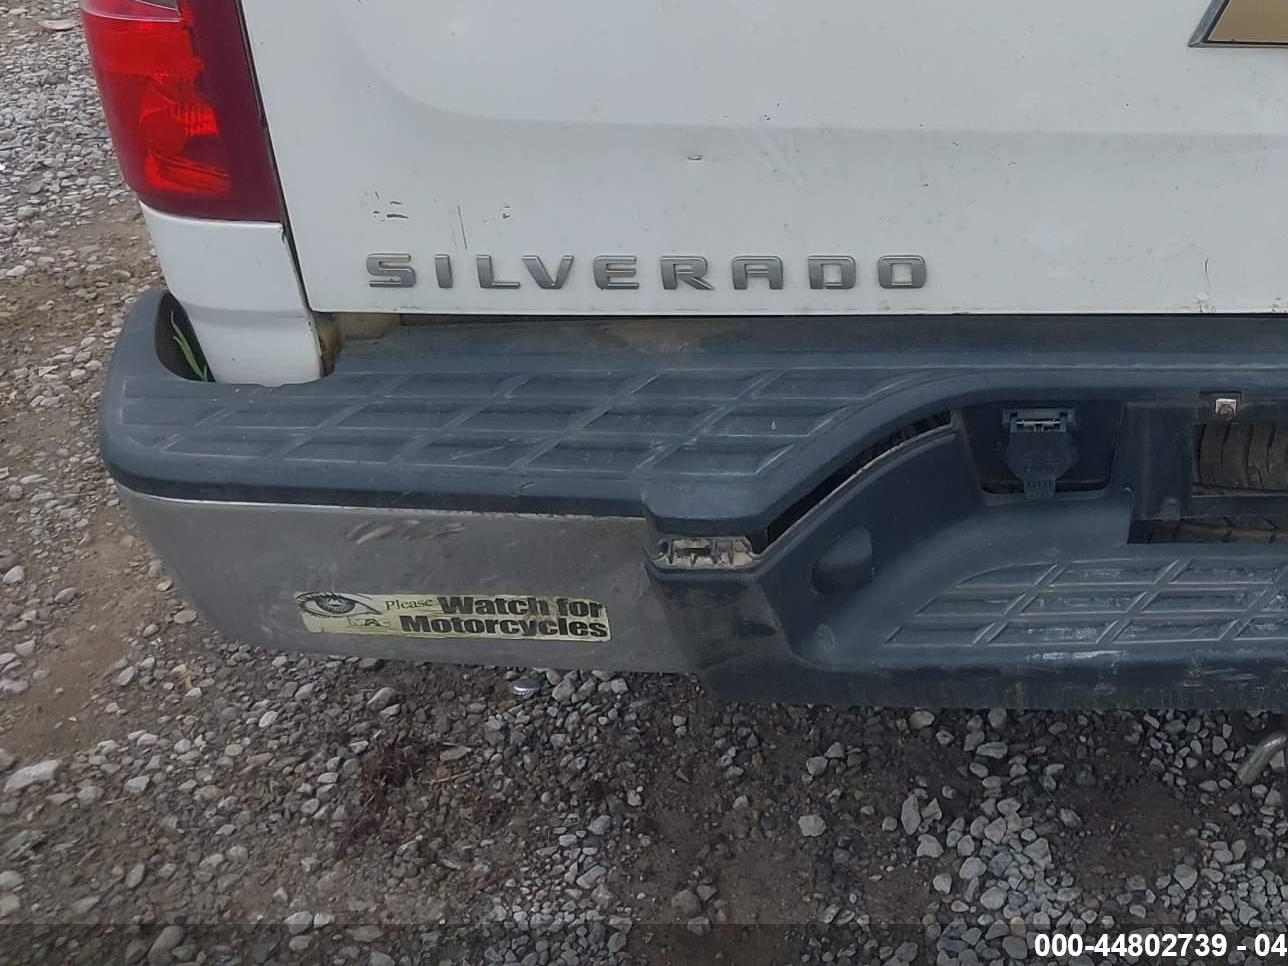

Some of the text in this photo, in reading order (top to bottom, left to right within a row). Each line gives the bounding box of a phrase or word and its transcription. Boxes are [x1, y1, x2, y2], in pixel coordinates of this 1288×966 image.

[366, 252, 928, 291] SILVERADO
[385, 596, 604, 619] Please Watch for
[399, 615, 609, 638] Motorcycles
